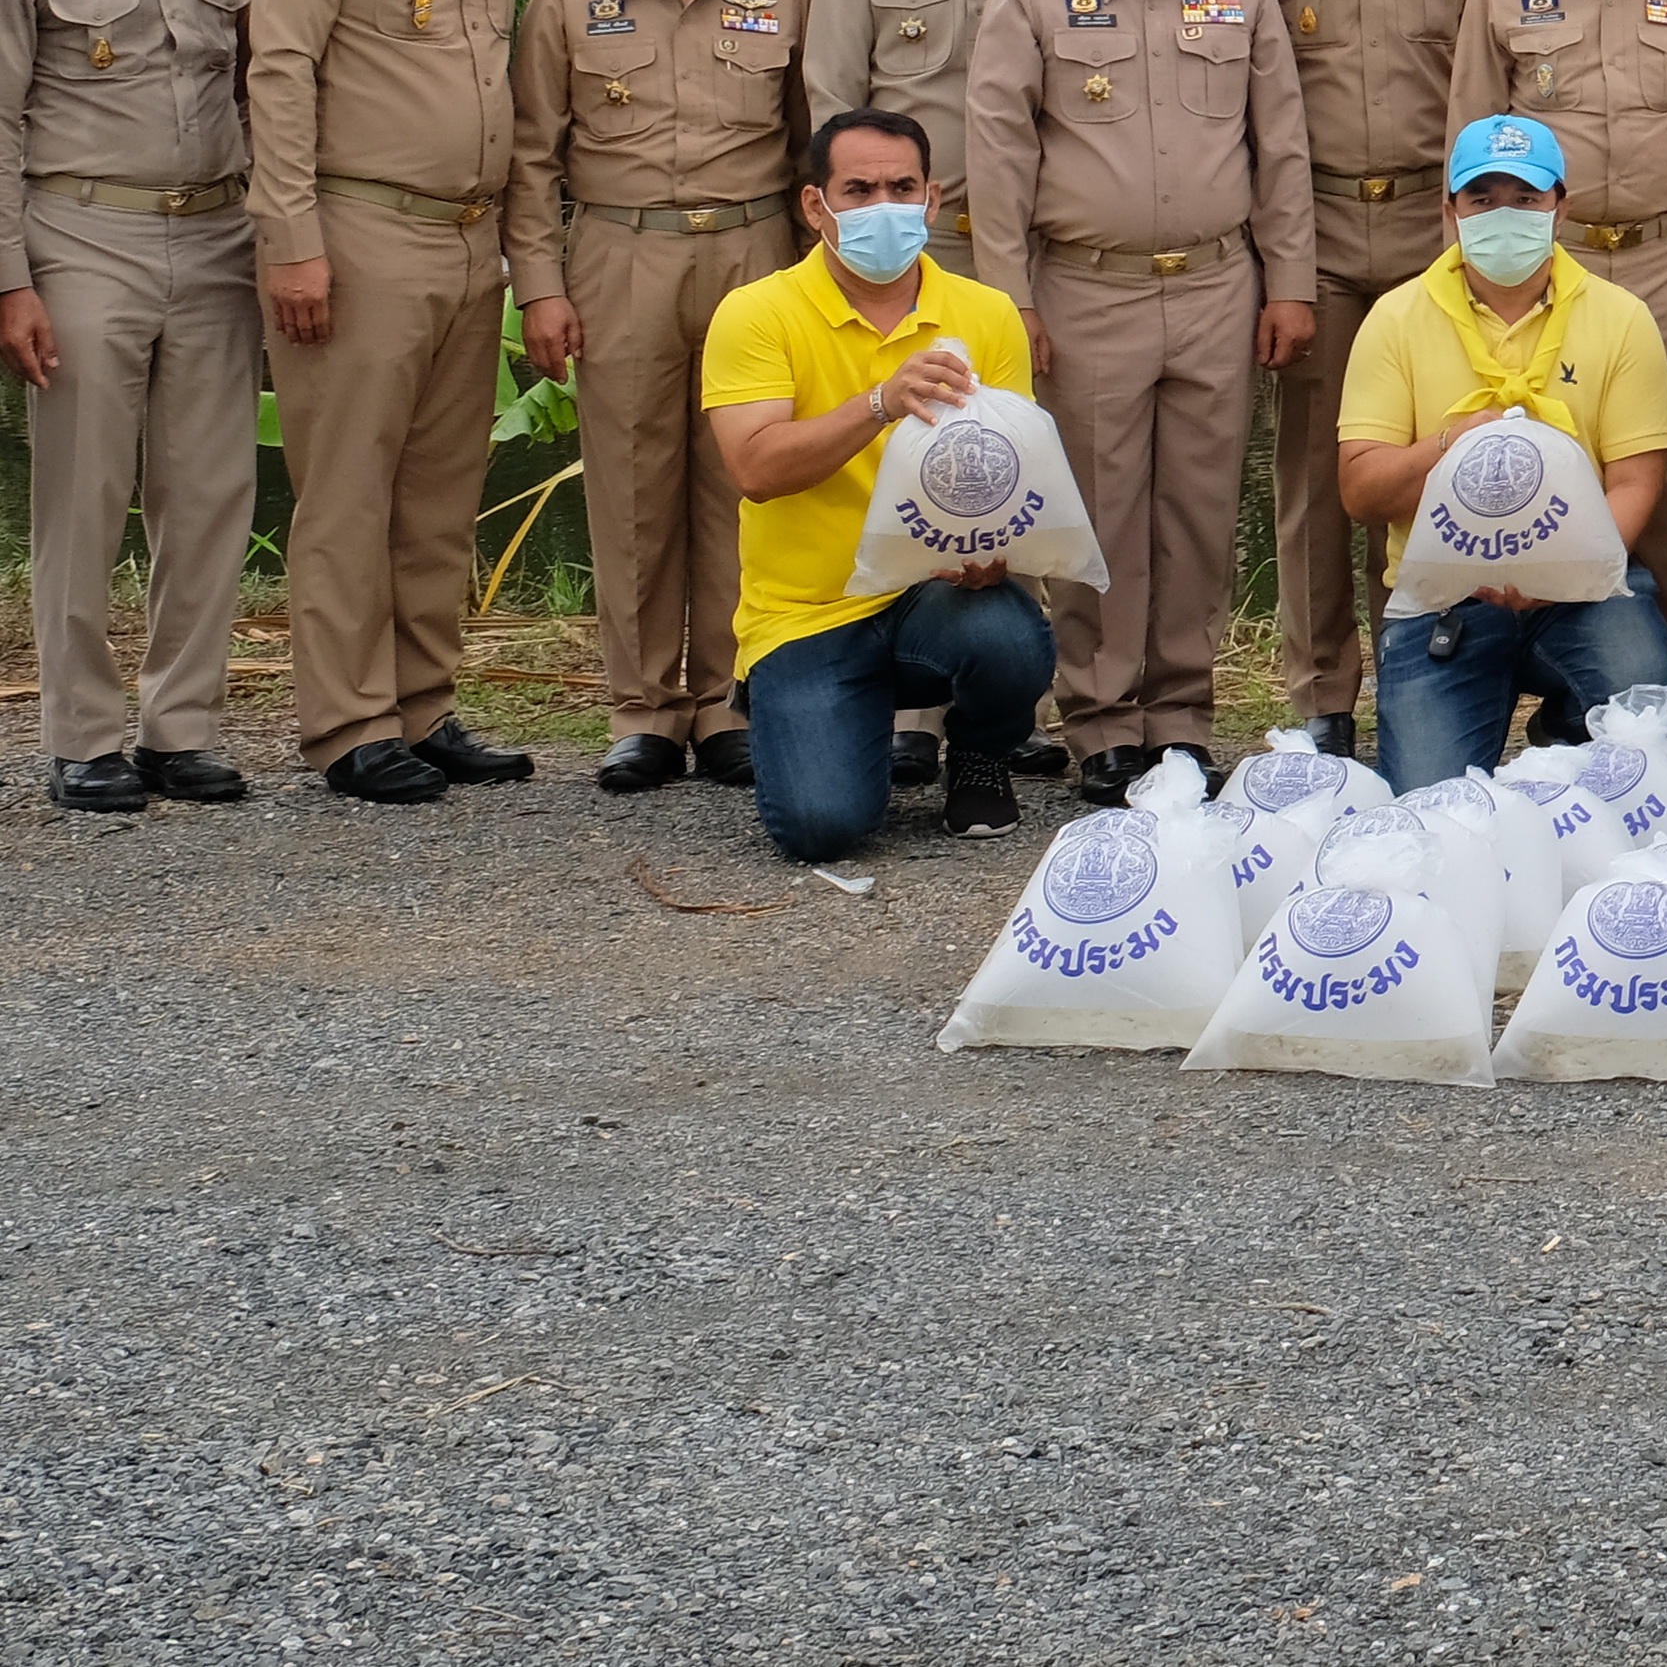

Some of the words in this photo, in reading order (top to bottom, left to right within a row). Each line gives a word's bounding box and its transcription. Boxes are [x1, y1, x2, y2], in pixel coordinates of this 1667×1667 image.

[895, 489, 1045, 554] กรมประมง
[1429, 494, 1570, 560] กรมประมง
[1014, 906, 1178, 978] กรมประมง
[1259, 938, 1419, 1012] กรมประมง
